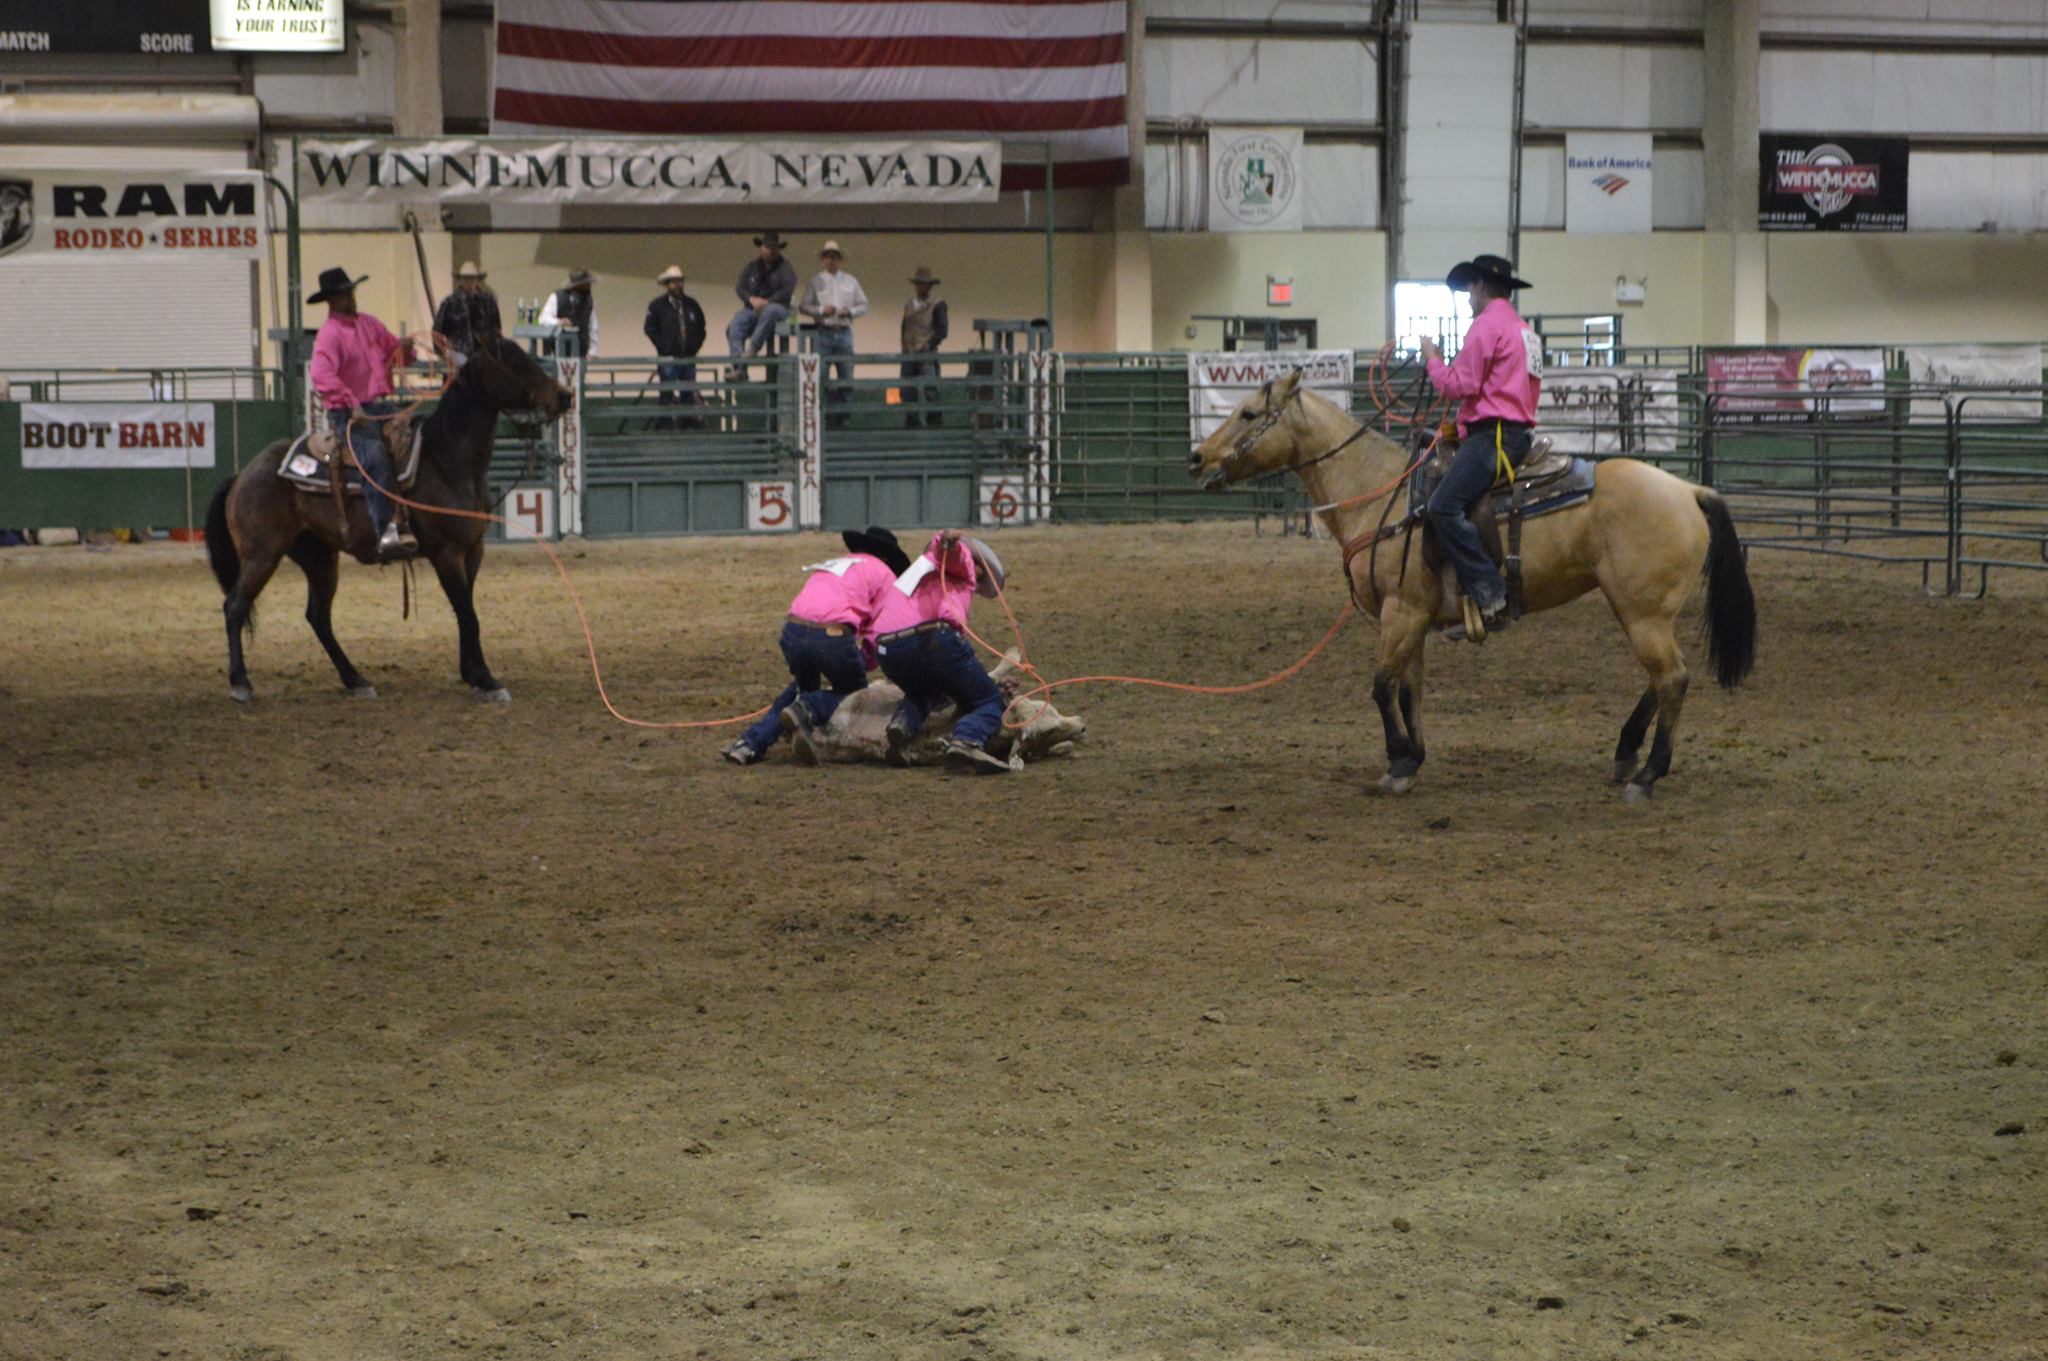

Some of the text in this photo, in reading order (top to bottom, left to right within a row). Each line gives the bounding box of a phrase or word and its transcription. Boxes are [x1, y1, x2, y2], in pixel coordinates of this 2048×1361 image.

[235, 17, 274, 33] YOUR
[0, 31, 50, 51] MATCH
[140, 32, 194, 53] SCORE
[1608, 156, 1652, 169] America
[1777, 150, 1805, 165] THE
[304, 152, 994, 198] WINNEMUCCA, NEVADA
[53, 183, 255, 218] RAM
[54, 227, 258, 250] RODEO SERIES
[23, 421, 205, 449] BOOT BARN
[759, 485, 789, 527] 5
[991, 480, 1018, 518] 6
[516, 493, 543, 534] 4
